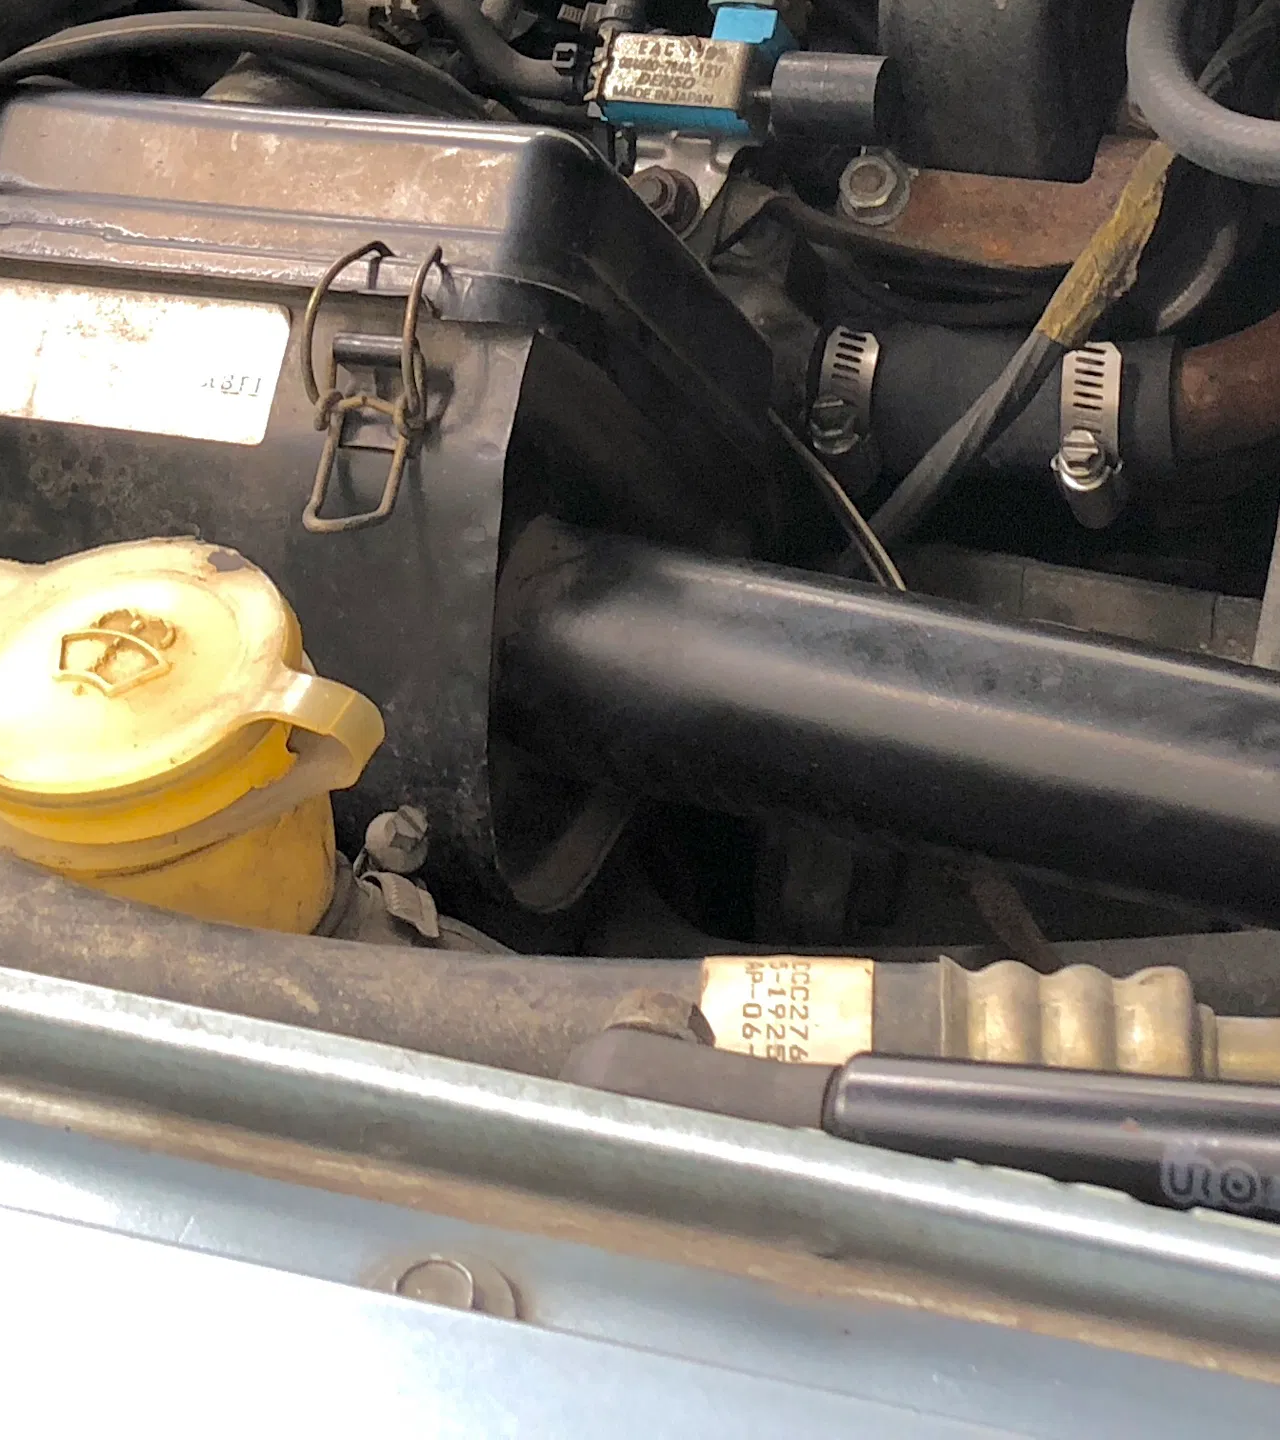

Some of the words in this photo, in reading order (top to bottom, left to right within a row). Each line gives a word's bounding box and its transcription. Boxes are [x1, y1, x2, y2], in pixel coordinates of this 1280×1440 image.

[635, 71, 696, 90] DENSO
[612, 85, 652, 100] MADE
[669, 90, 714, 104] JAPAN
